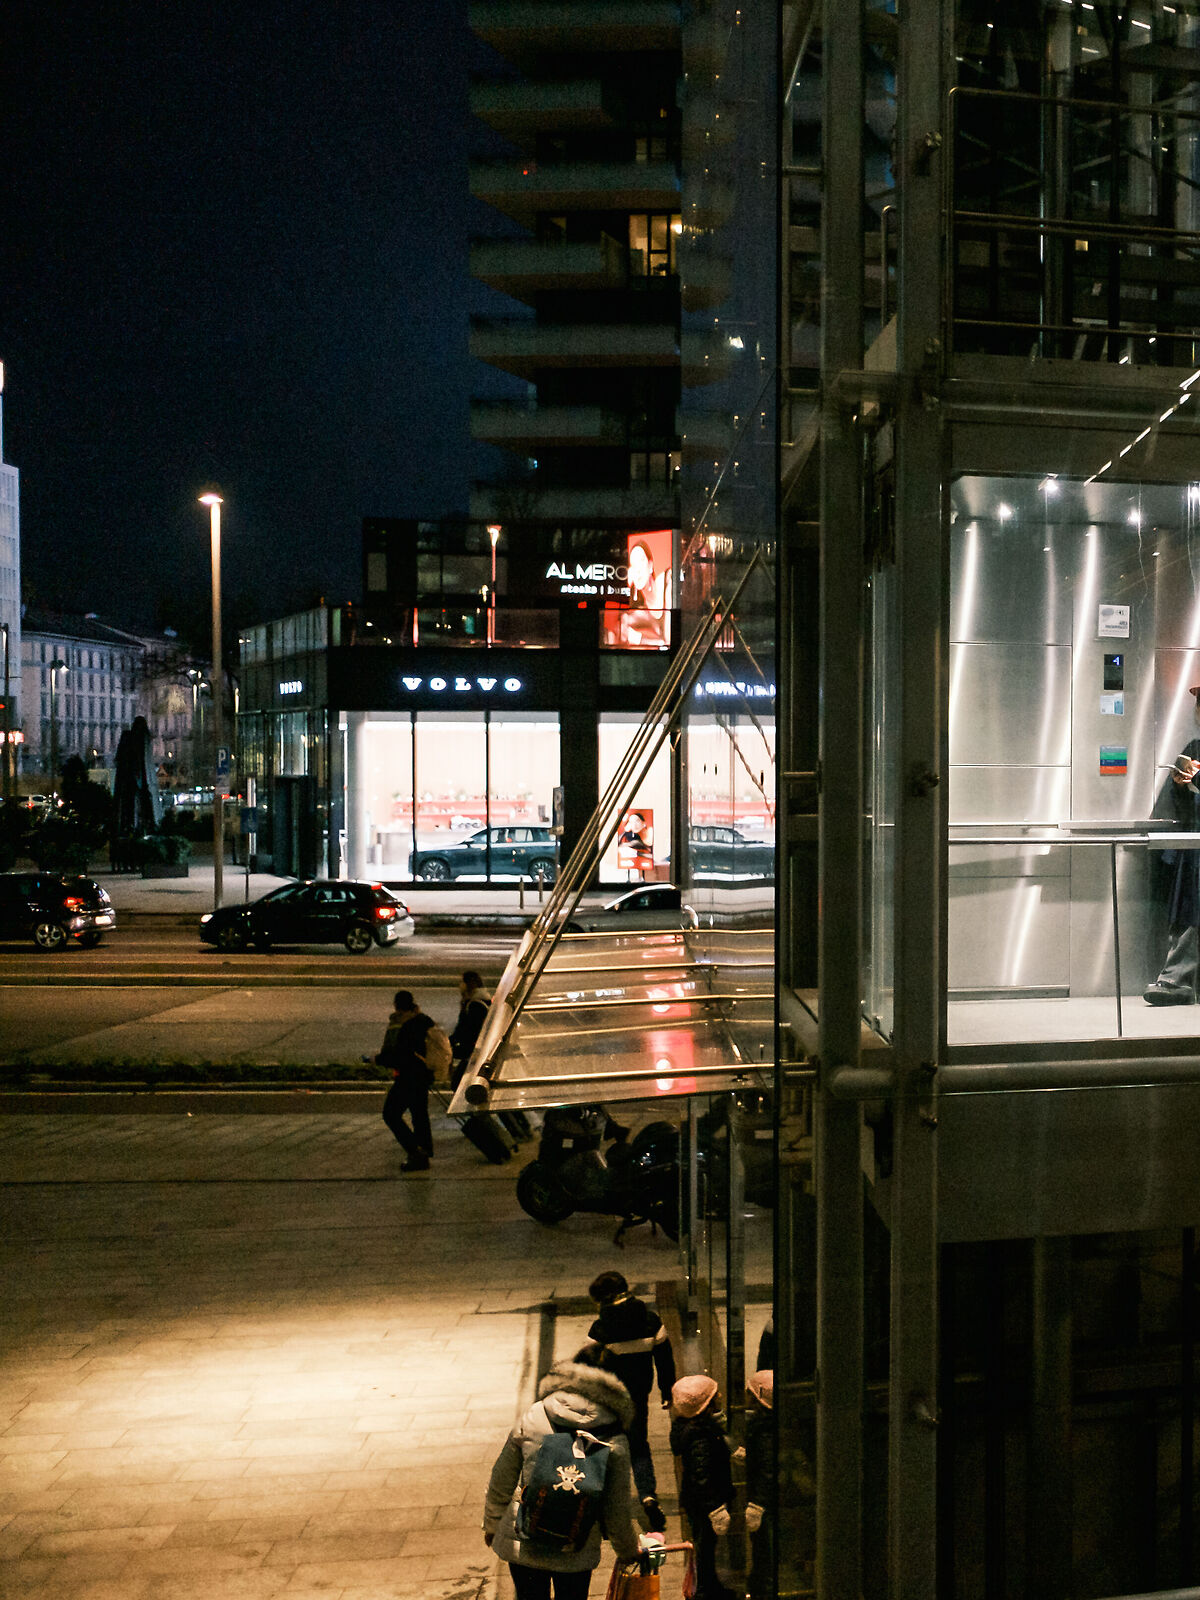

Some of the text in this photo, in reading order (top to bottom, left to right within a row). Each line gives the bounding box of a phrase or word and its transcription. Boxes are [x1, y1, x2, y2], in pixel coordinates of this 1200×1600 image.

[575, 563, 629, 581] MERC
[607, 585, 631, 597] burg
[402, 677, 522, 692] VOLVO
[218, 748, 227, 768] P
